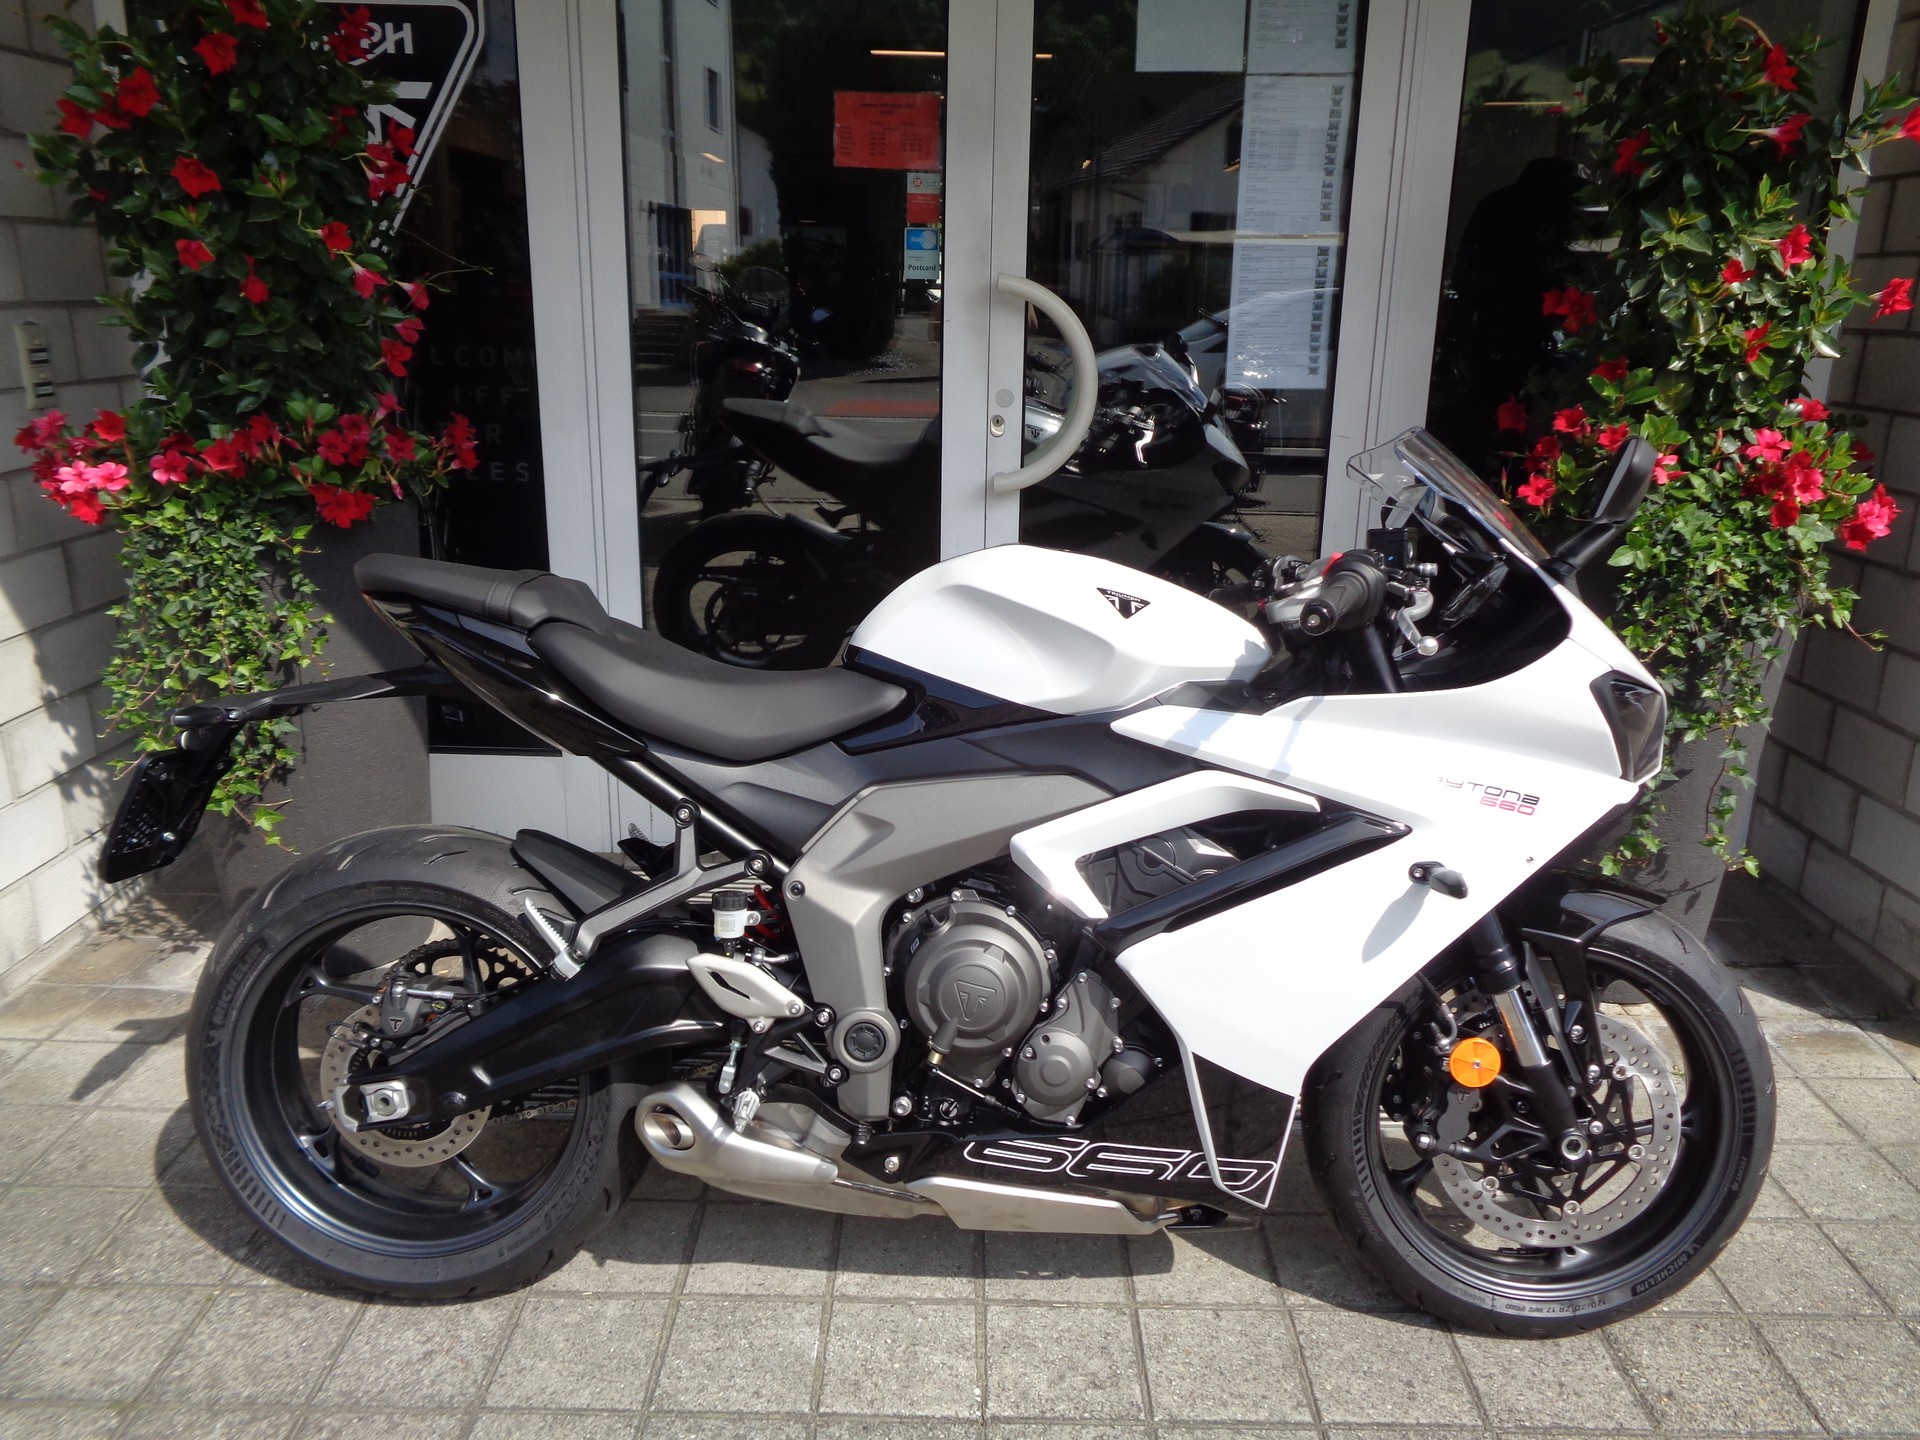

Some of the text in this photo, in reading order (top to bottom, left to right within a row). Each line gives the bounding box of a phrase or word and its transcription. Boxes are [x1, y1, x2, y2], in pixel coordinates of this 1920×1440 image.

[908, 264, 936, 272] Postcard
[1480, 796, 1535, 816] 660
[1636, 1252, 1688, 1295] MICHELIN
[1575, 1299, 1606, 1312] 120/70
